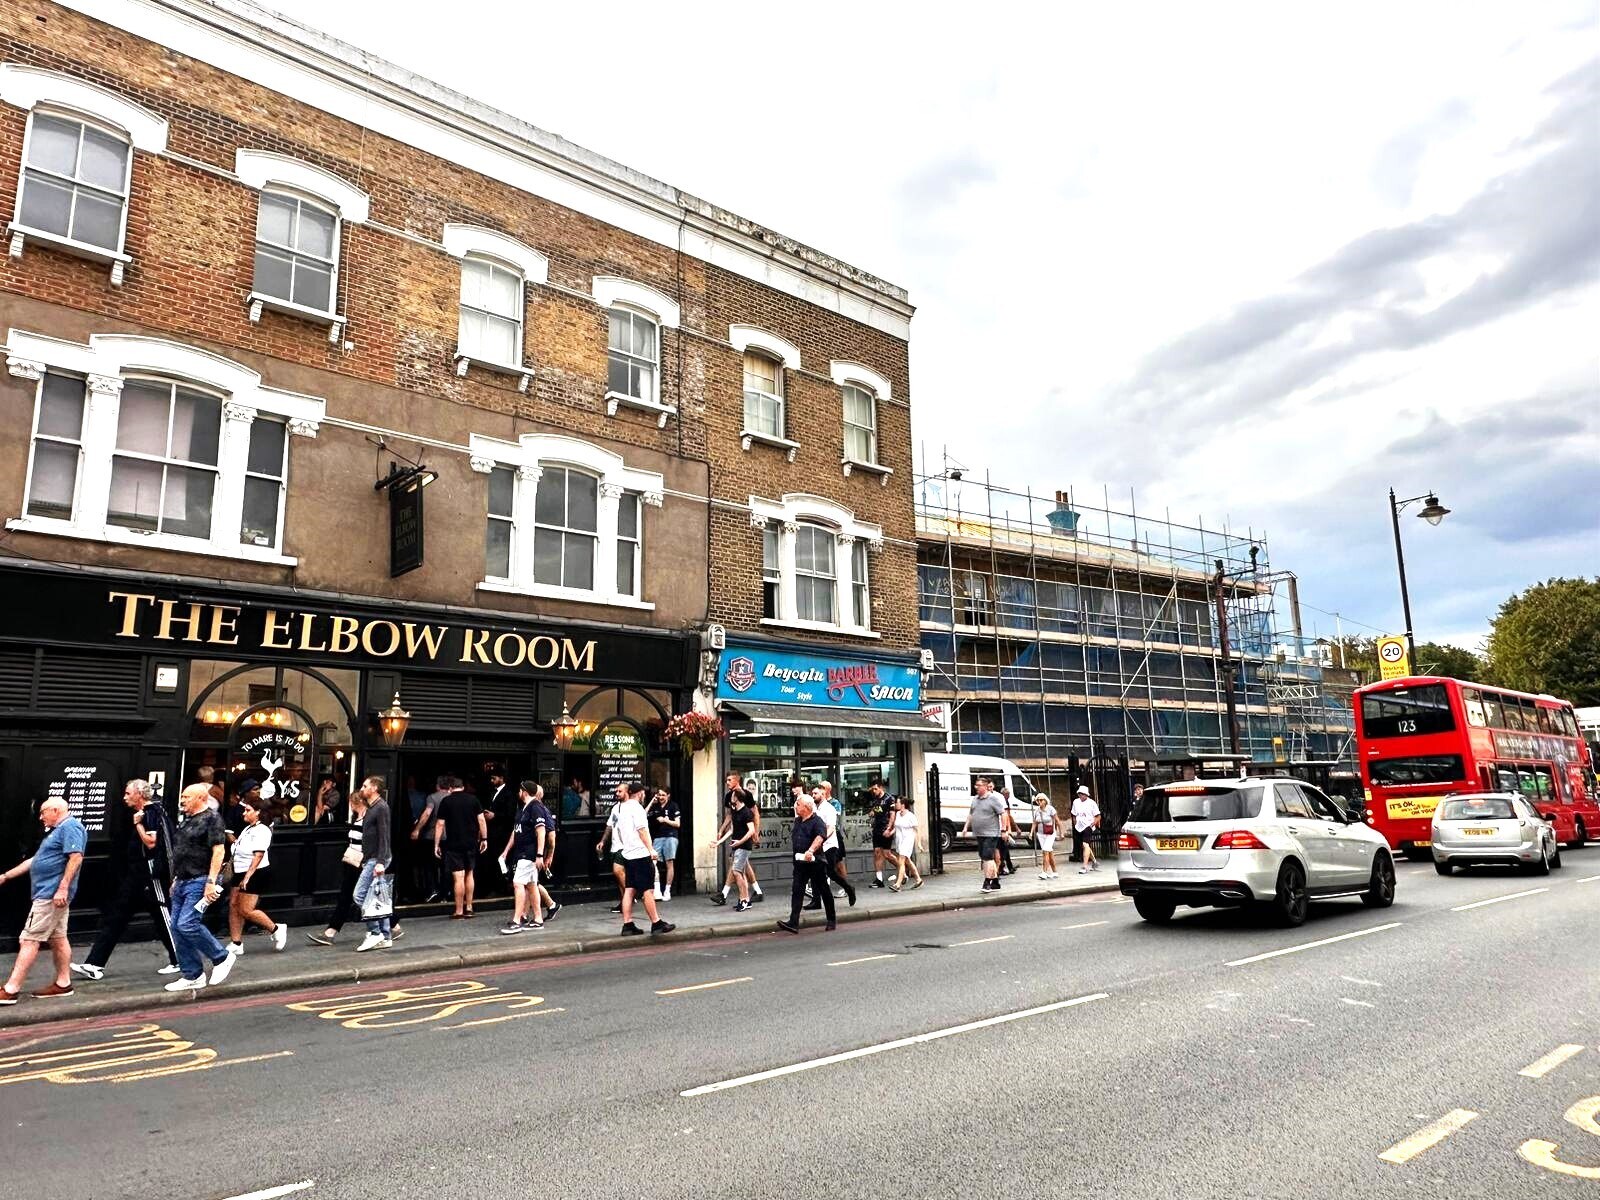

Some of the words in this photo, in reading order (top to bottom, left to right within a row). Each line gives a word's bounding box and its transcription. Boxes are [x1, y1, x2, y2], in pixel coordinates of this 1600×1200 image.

[108, 592, 241, 645] THE
[260, 610, 449, 660] ELBOW
[459, 628, 598, 672] ROOM
[1384, 648, 1400, 656] 20
[763, 663, 825, 683] Beyoglu
[796, 692, 813, 701] Style
[1398, 720, 1416, 732] 123
[241, 742, 253, 752] TO
[252, 734, 273, 746] DARE
[285, 736, 294, 745] TO
[294, 742, 305, 753] DO
[604, 735, 635, 744] REASONS
